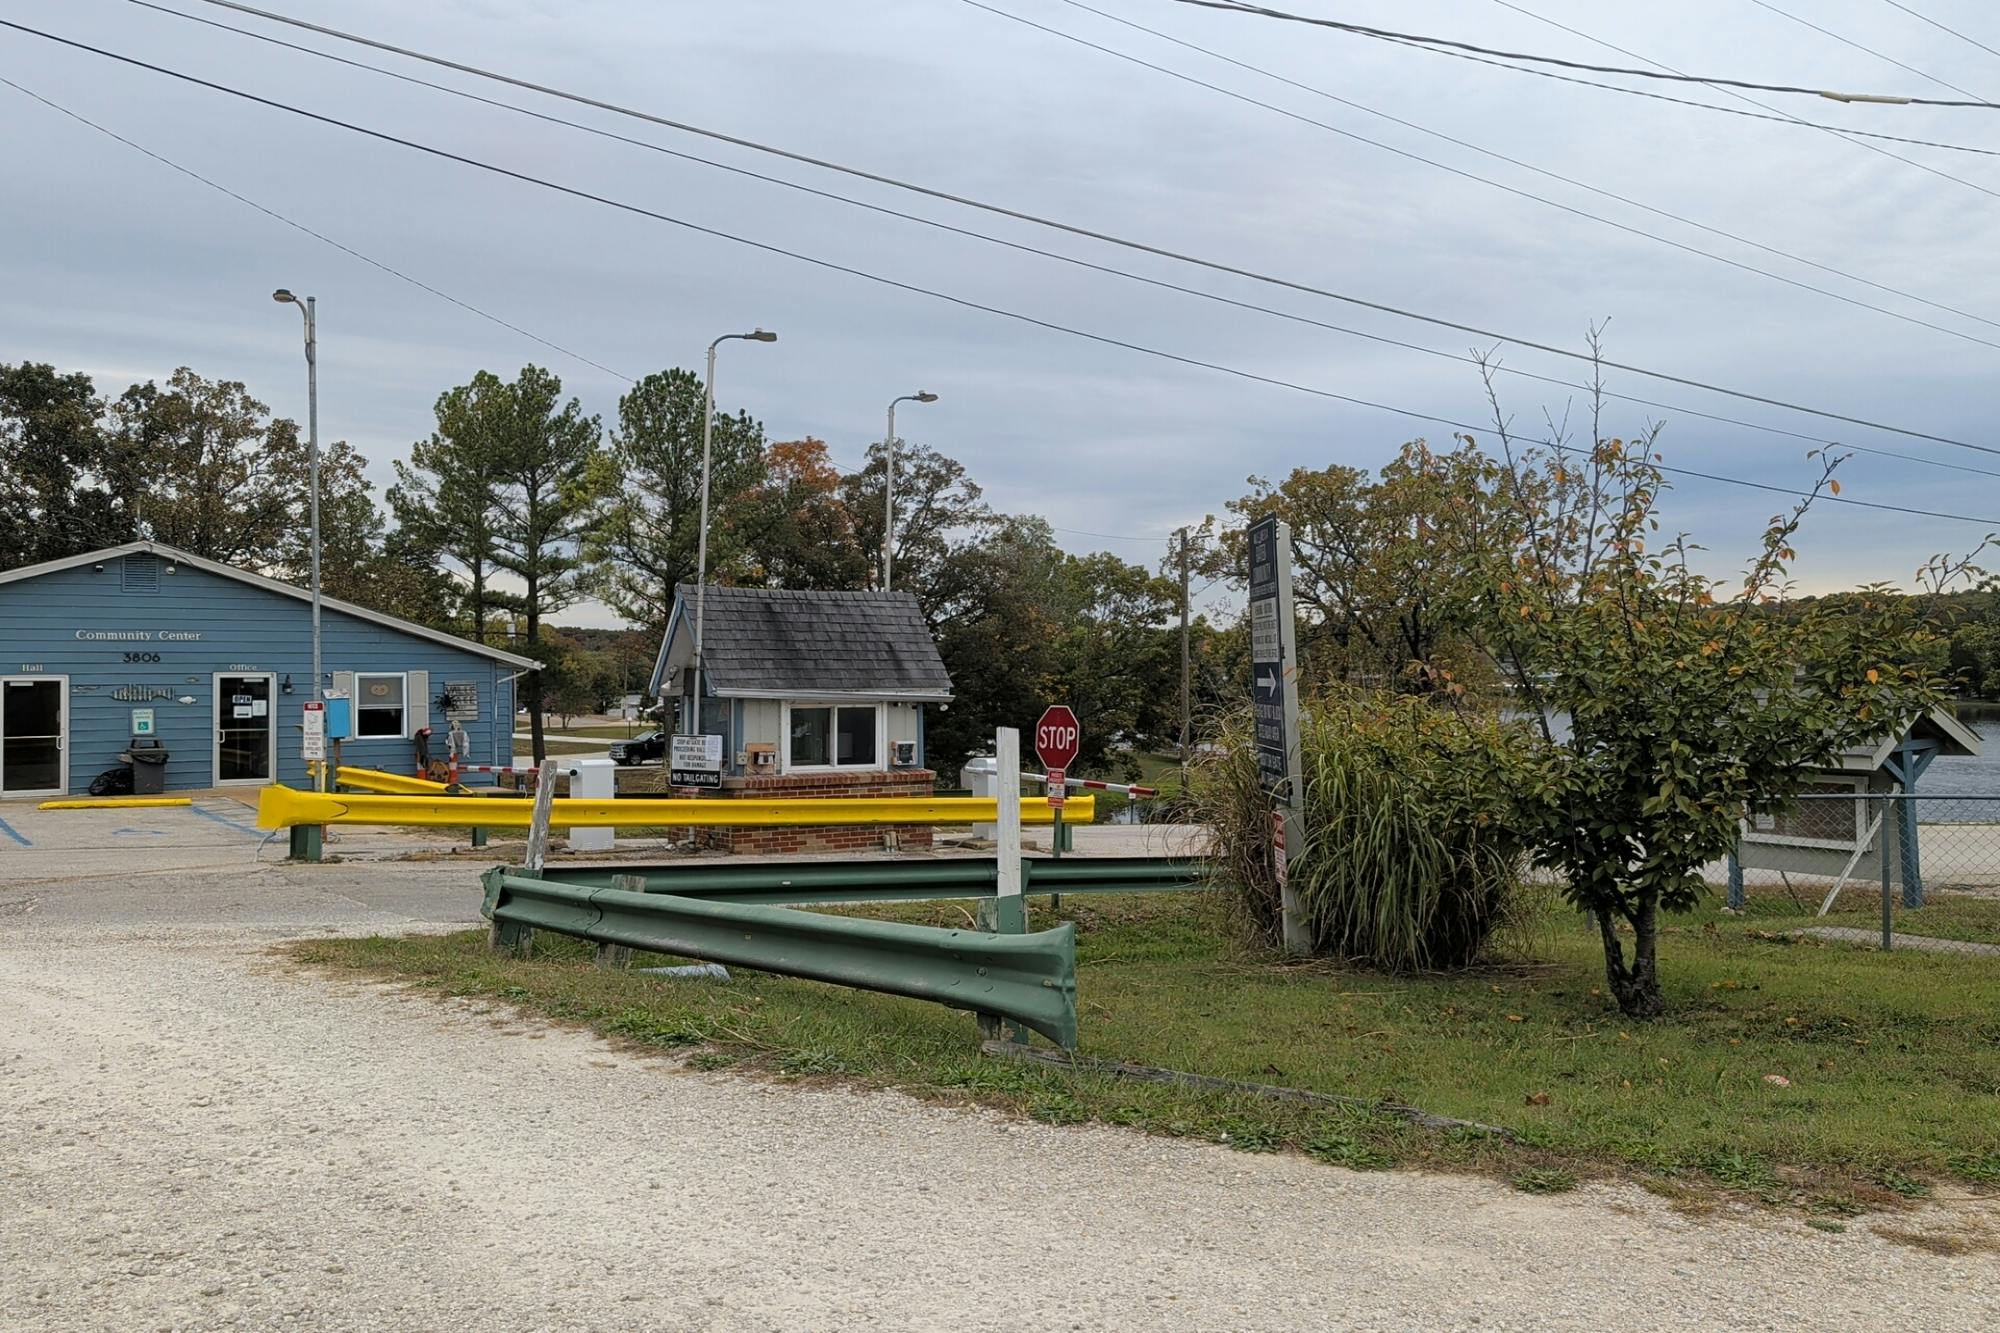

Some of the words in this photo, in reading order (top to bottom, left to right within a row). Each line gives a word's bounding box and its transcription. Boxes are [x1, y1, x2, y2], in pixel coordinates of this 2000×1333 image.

[75, 630, 152, 641] Community
[158, 630, 201, 641] Center
[123, 652, 161, 663] 3806
[22, 664, 44, 672] Hall
[229, 663, 257, 671] Office
[1039, 725, 1076, 750] STOP
[673, 773, 682, 782] NO
[682, 773, 718, 784] TAILGATING
